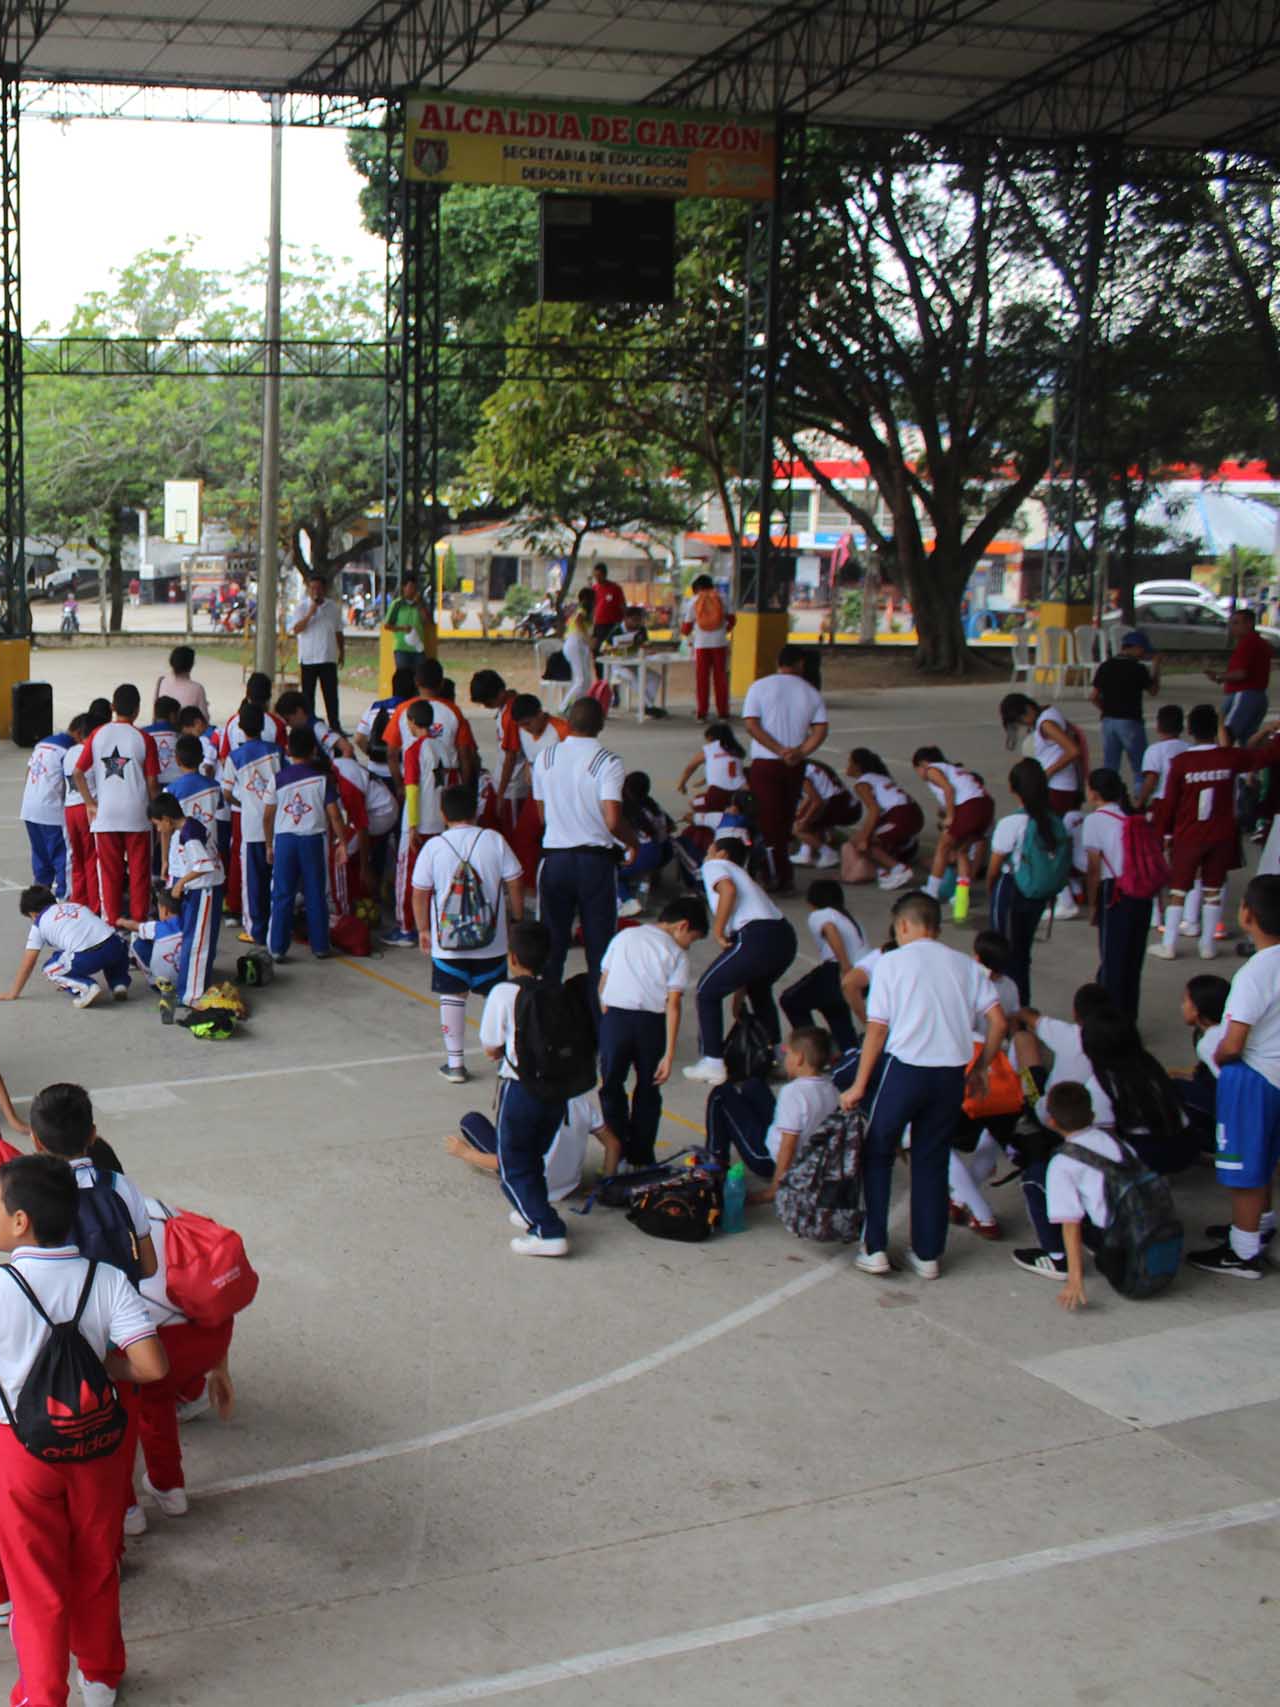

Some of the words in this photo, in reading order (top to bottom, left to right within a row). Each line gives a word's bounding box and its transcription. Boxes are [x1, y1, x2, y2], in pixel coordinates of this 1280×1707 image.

[590, 116, 630, 145] DE
[636, 119, 762, 152] GARZÓN
[521, 166, 583, 183] DEPORTE
[587, 170, 596, 183] Y
[41, 1428, 121, 1458] adidas
